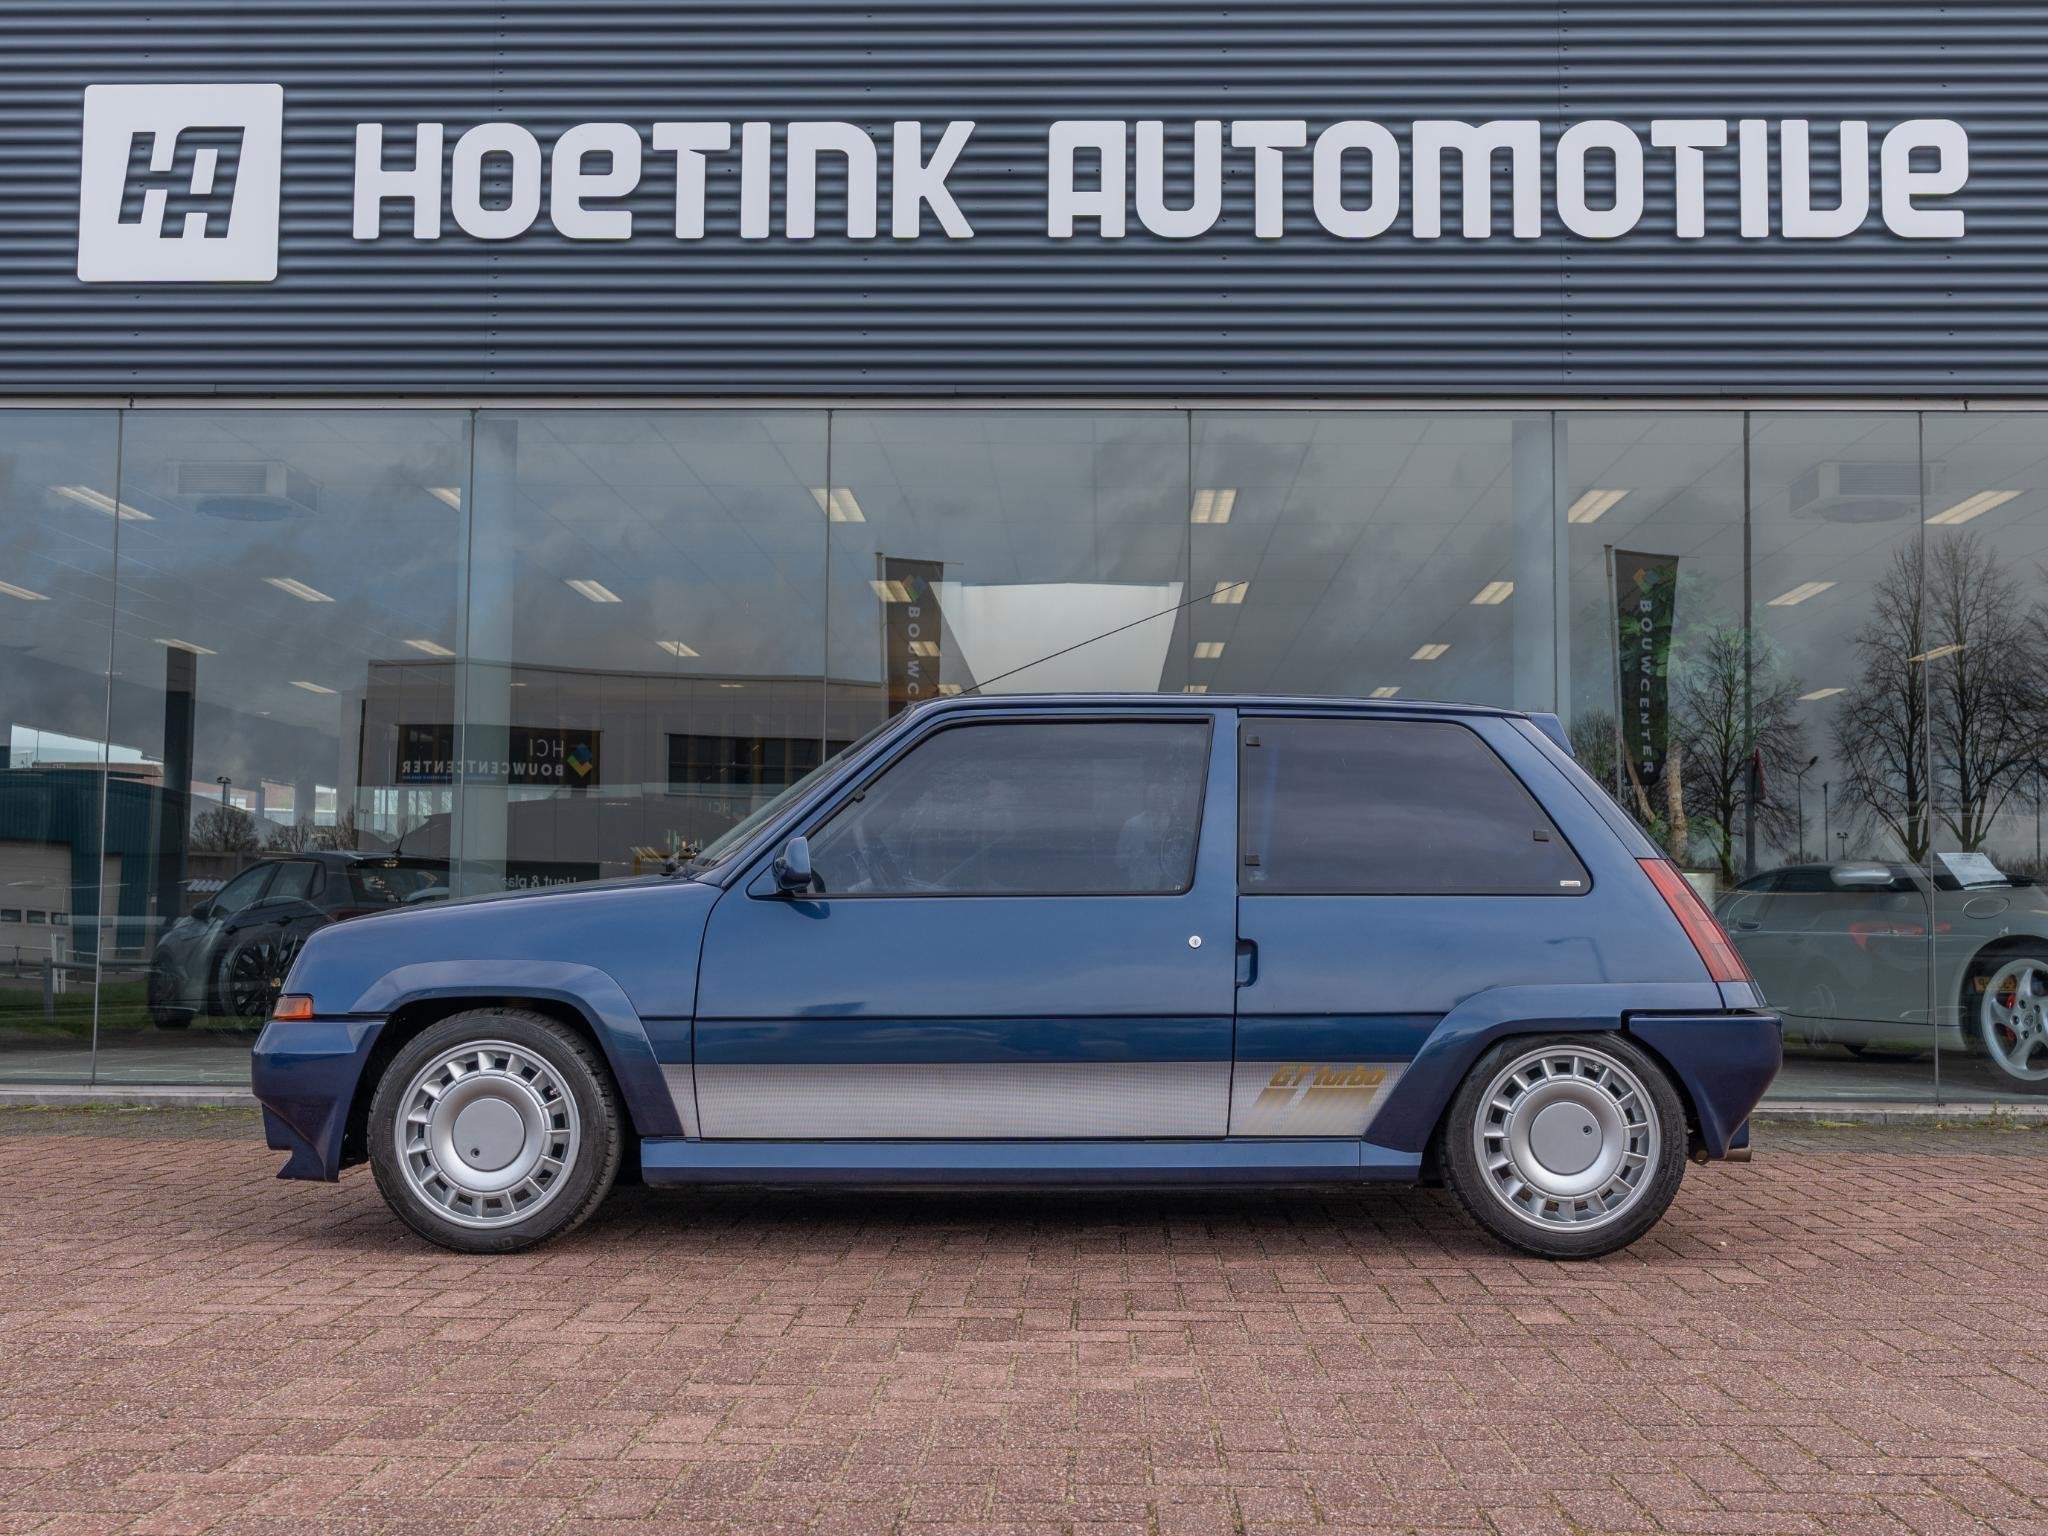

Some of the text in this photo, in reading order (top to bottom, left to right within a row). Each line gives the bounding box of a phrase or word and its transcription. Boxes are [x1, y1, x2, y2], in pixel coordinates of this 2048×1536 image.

[907, 606, 921, 706] BOWC
[1639, 599, 1654, 774] BOUWCENTER
[1269, 1065, 1313, 1087] GT
